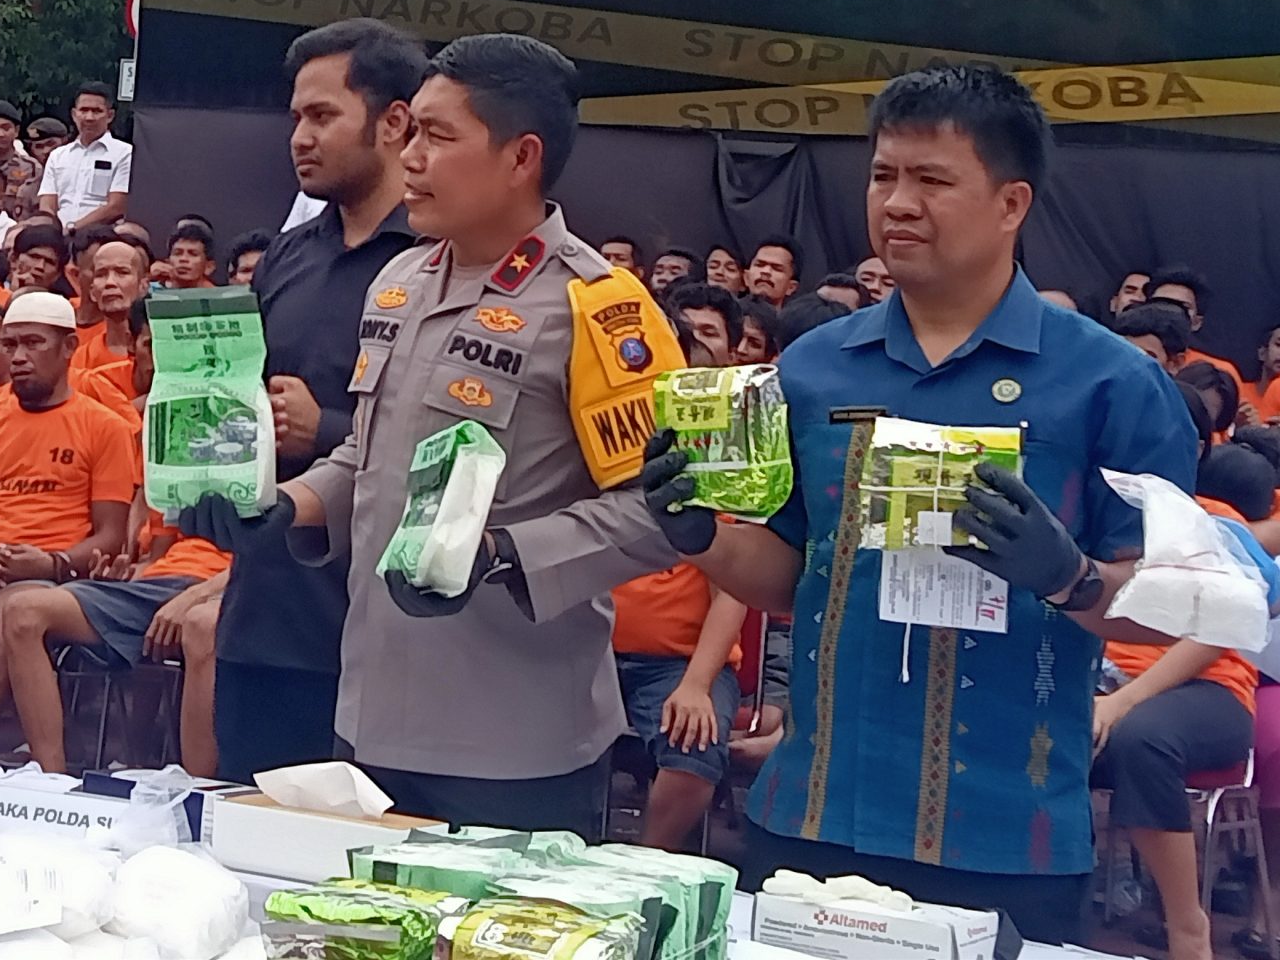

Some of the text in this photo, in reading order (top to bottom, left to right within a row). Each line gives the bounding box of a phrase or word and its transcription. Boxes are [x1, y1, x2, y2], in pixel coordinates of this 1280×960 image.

[683, 28, 845, 72] STOP
[678, 96, 839, 130] STOP
[597, 304, 637, 322] POLDA
[448, 335, 523, 376] POLRI
[49, 446, 75, 464] 18
[33, 807, 90, 828] POLDA
[829, 913, 888, 933] Altamed
